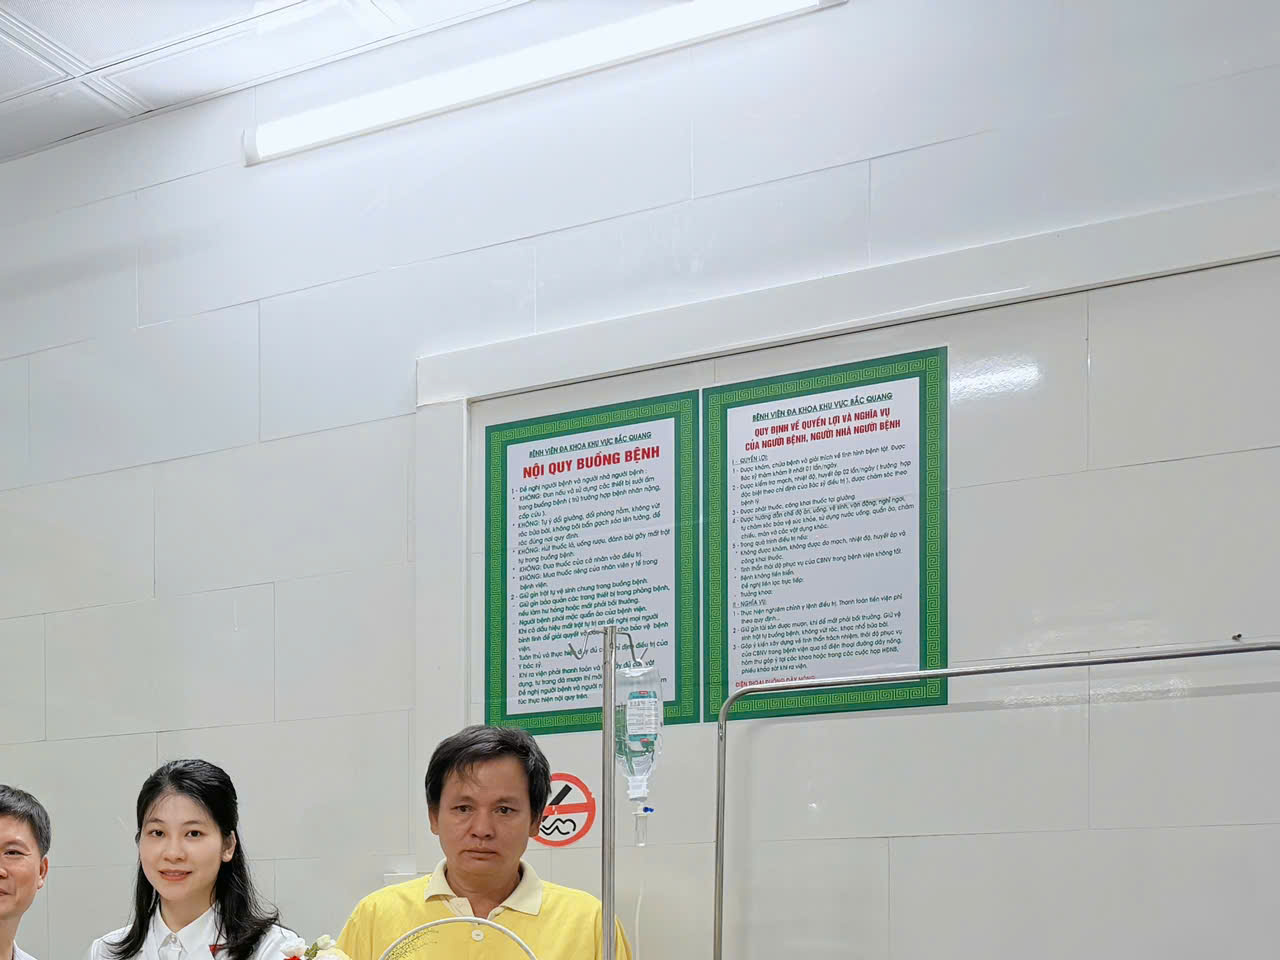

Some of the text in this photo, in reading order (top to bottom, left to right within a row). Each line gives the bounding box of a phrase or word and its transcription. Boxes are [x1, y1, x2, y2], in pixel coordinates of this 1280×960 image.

[752, 392, 893, 422] BỆNH VIỆN ĐA KHOA KHU VỰC BẮC QUANG
[745, 419, 900, 451] CỦA NGƯỜI BỆNH, NGƯỜI NHÀ NGƯỜI BỆNH
[755, 408, 890, 438] QUY ĐỊNH VỀ QUYỀN LỢI VÀ NGHĨA VỤ
[529, 449, 544, 458] BỆNH
[544, 446, 558, 456] VIỆN
[569, 442, 586, 451] KHOA
[587, 440, 599, 448] KHU
[600, 438, 614, 446] VỰC
[614, 434, 628, 443] BẮC
[628, 432, 652, 440] QUANG
[523, 446, 660, 480] NỘI QUY BUỒNG BỆNH
